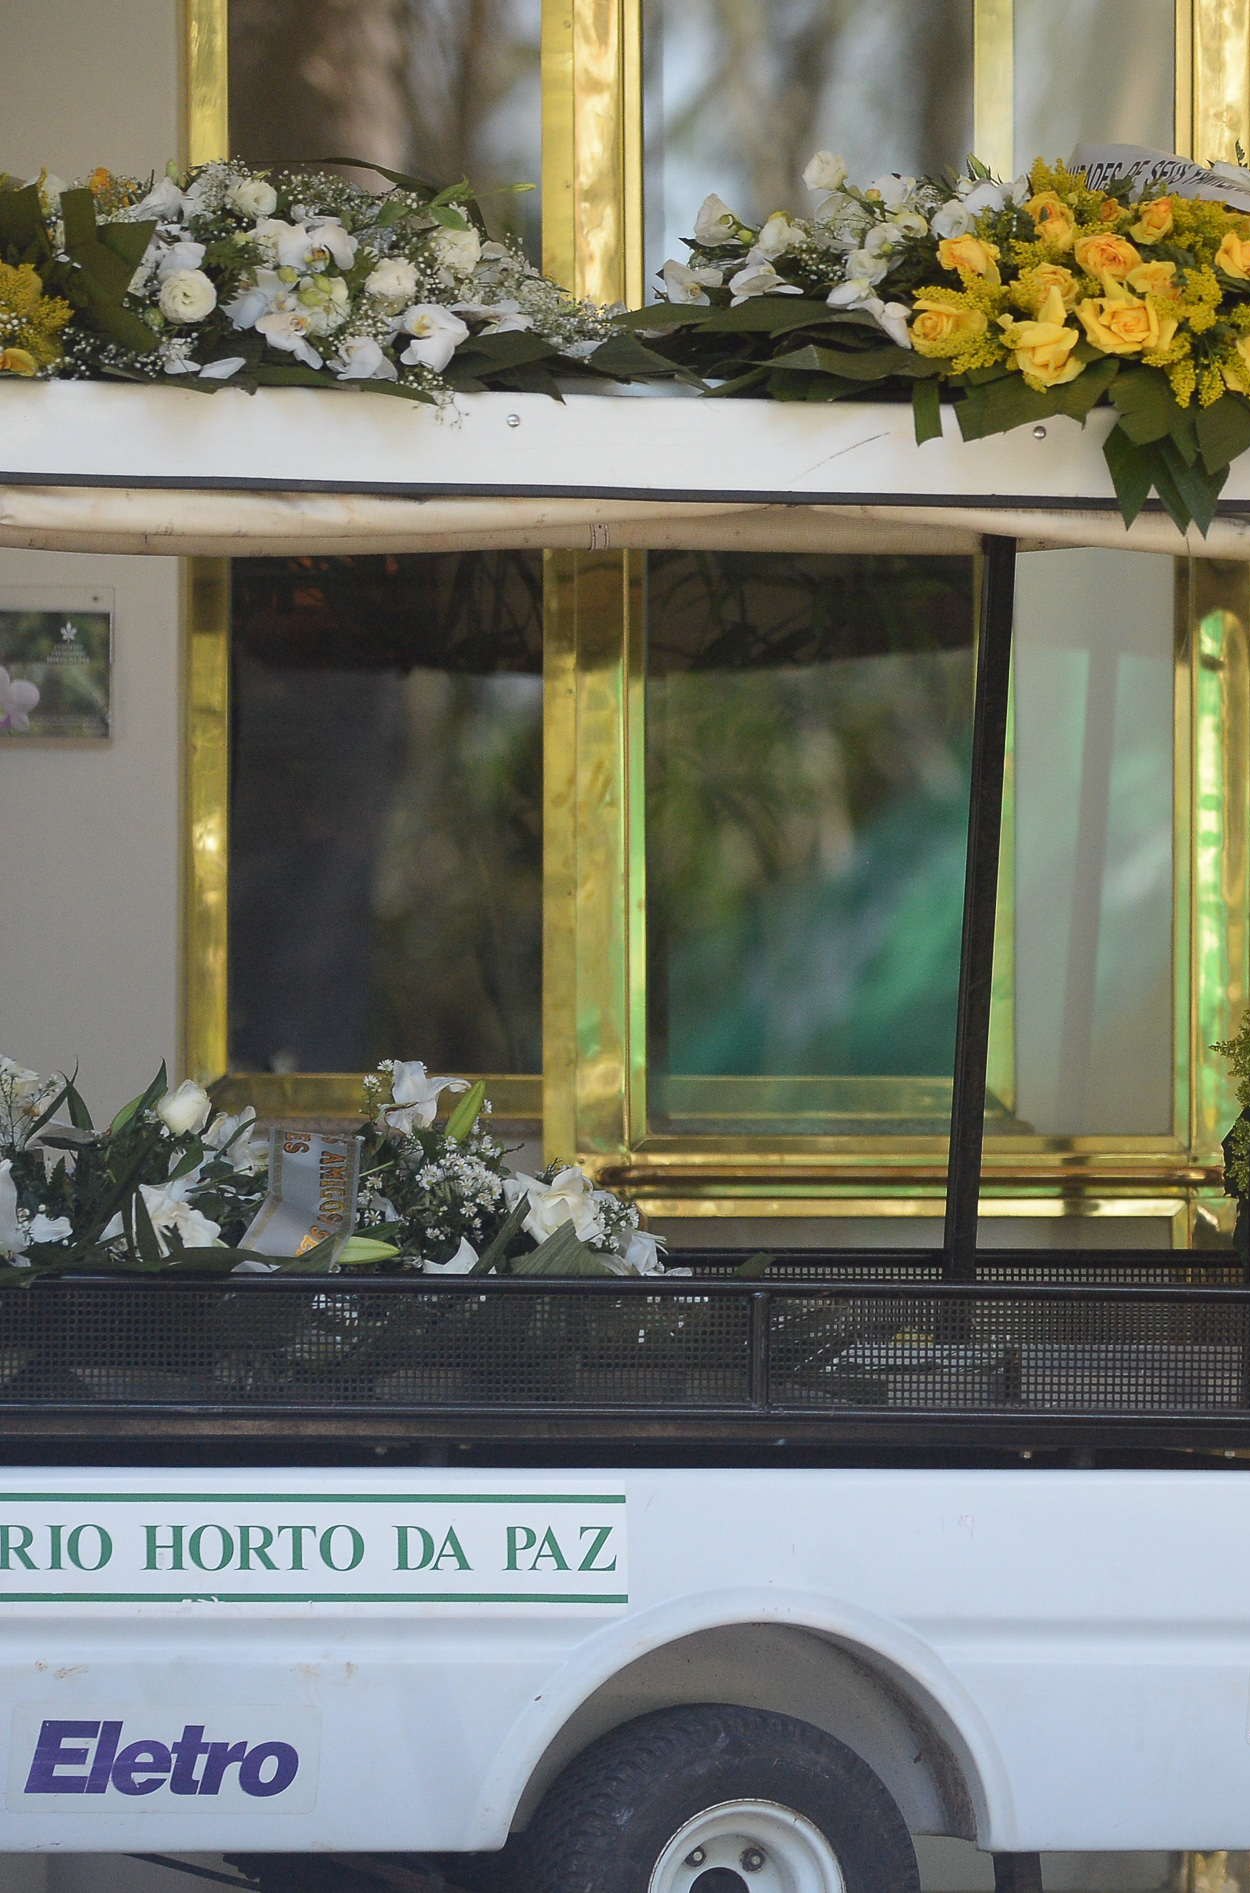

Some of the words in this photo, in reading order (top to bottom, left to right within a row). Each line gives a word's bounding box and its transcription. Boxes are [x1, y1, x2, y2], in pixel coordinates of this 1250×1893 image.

[140, 1523, 365, 1572] HORTO
[391, 1524, 473, 1572] DA
[502, 1525, 618, 1573] PAZ
[23, 1719, 300, 1798] Eletro
